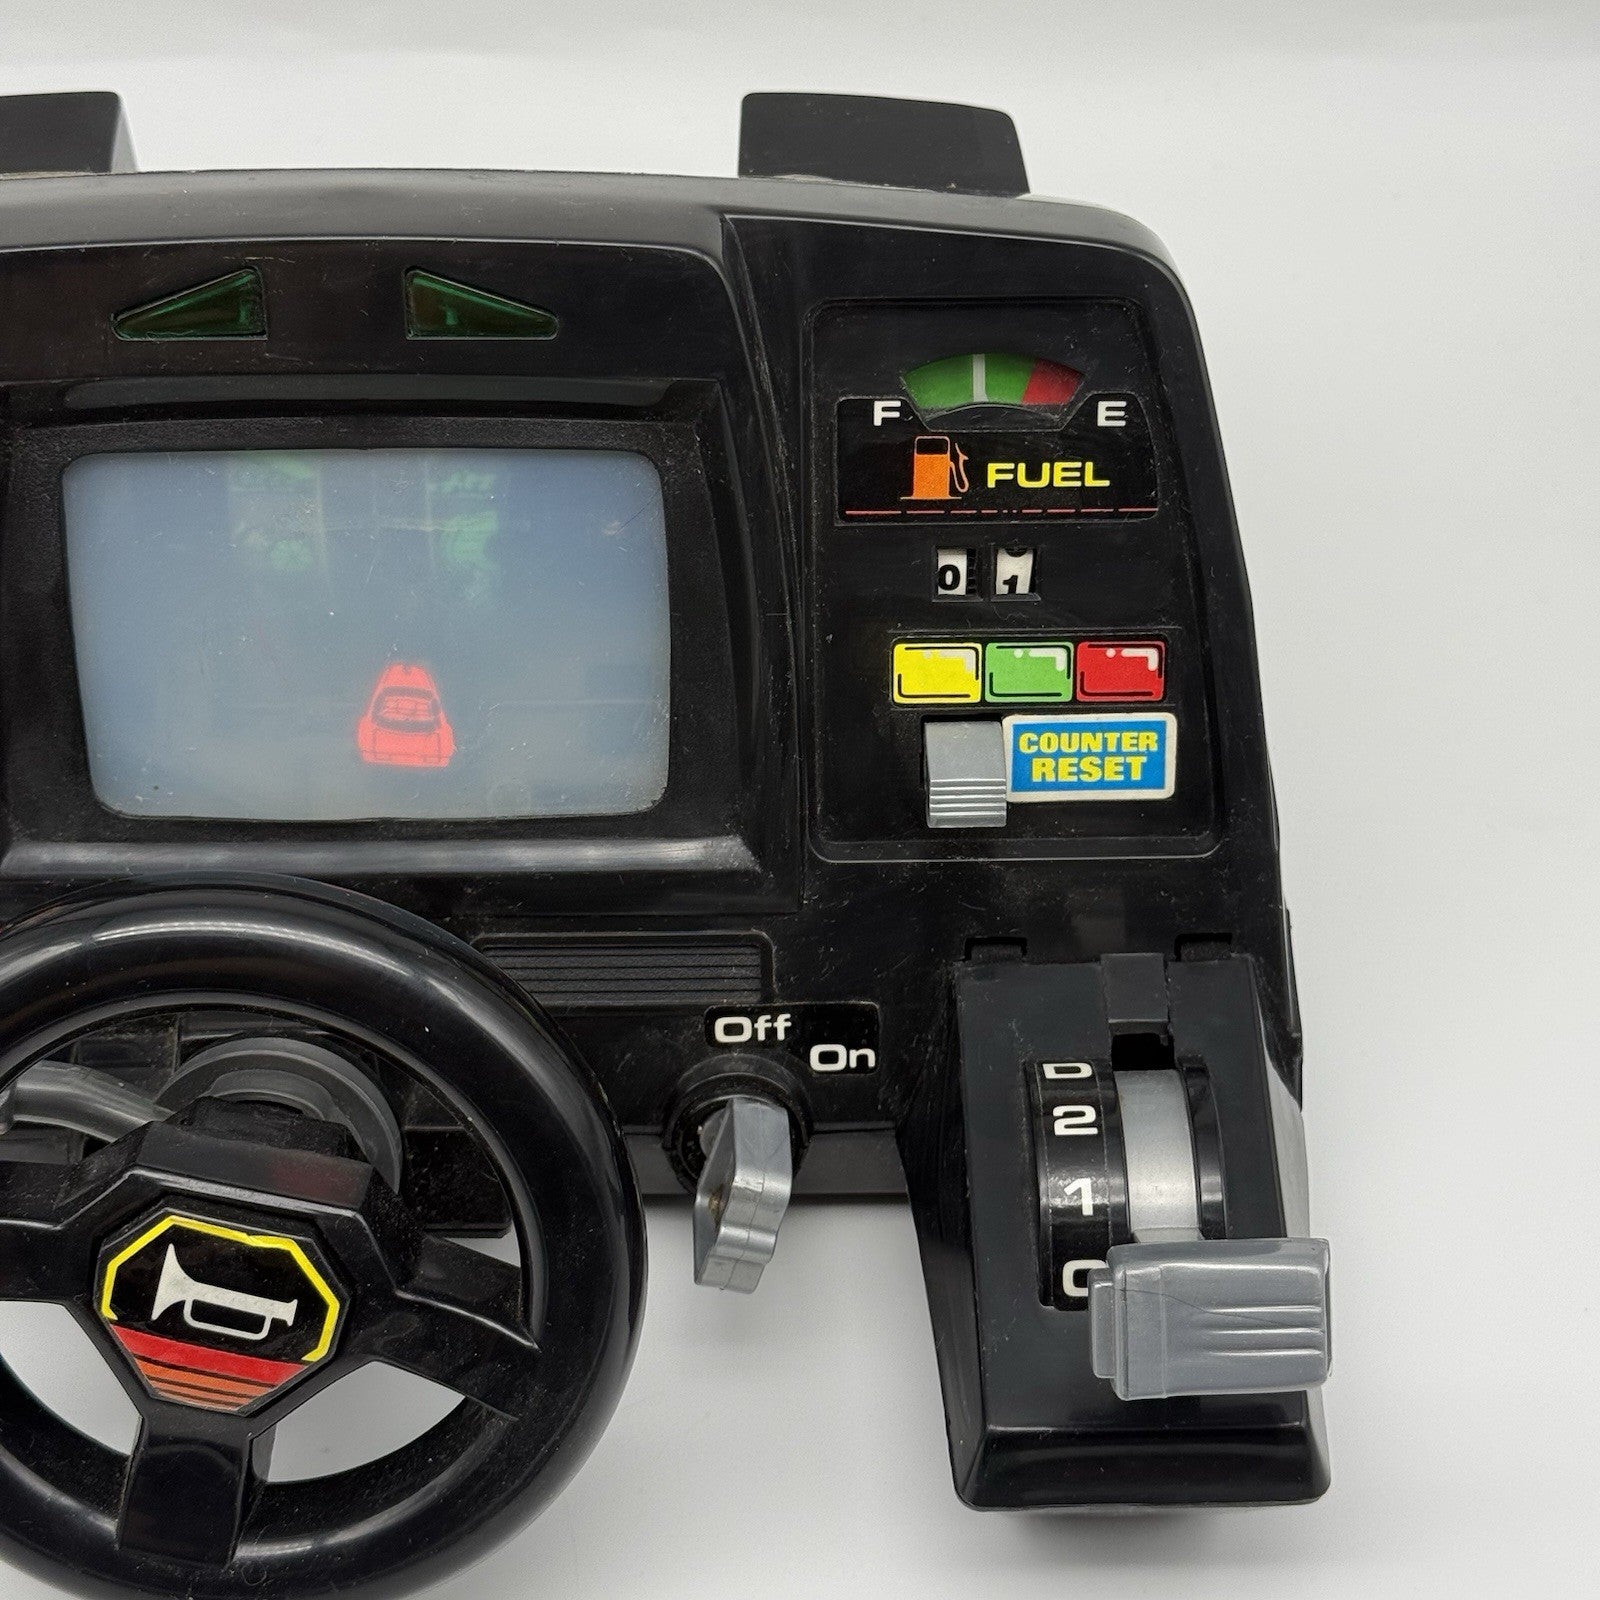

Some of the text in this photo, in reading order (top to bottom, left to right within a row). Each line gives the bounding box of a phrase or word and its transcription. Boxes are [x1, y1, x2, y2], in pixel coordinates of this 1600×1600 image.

[873, 400, 901, 427] F
[1097, 400, 1127, 427] E
[987, 461, 1110, 488] FUEL
[1018, 731, 1159, 754] COUNTER
[1031, 755, 1147, 782] RESET
[714, 1013, 792, 1043] Off
[809, 1044, 876, 1072] On
[1042, 1062, 1093, 1079] D
[1052, 1105, 1099, 1136] 2
[1063, 1178, 1094, 1216] 1
